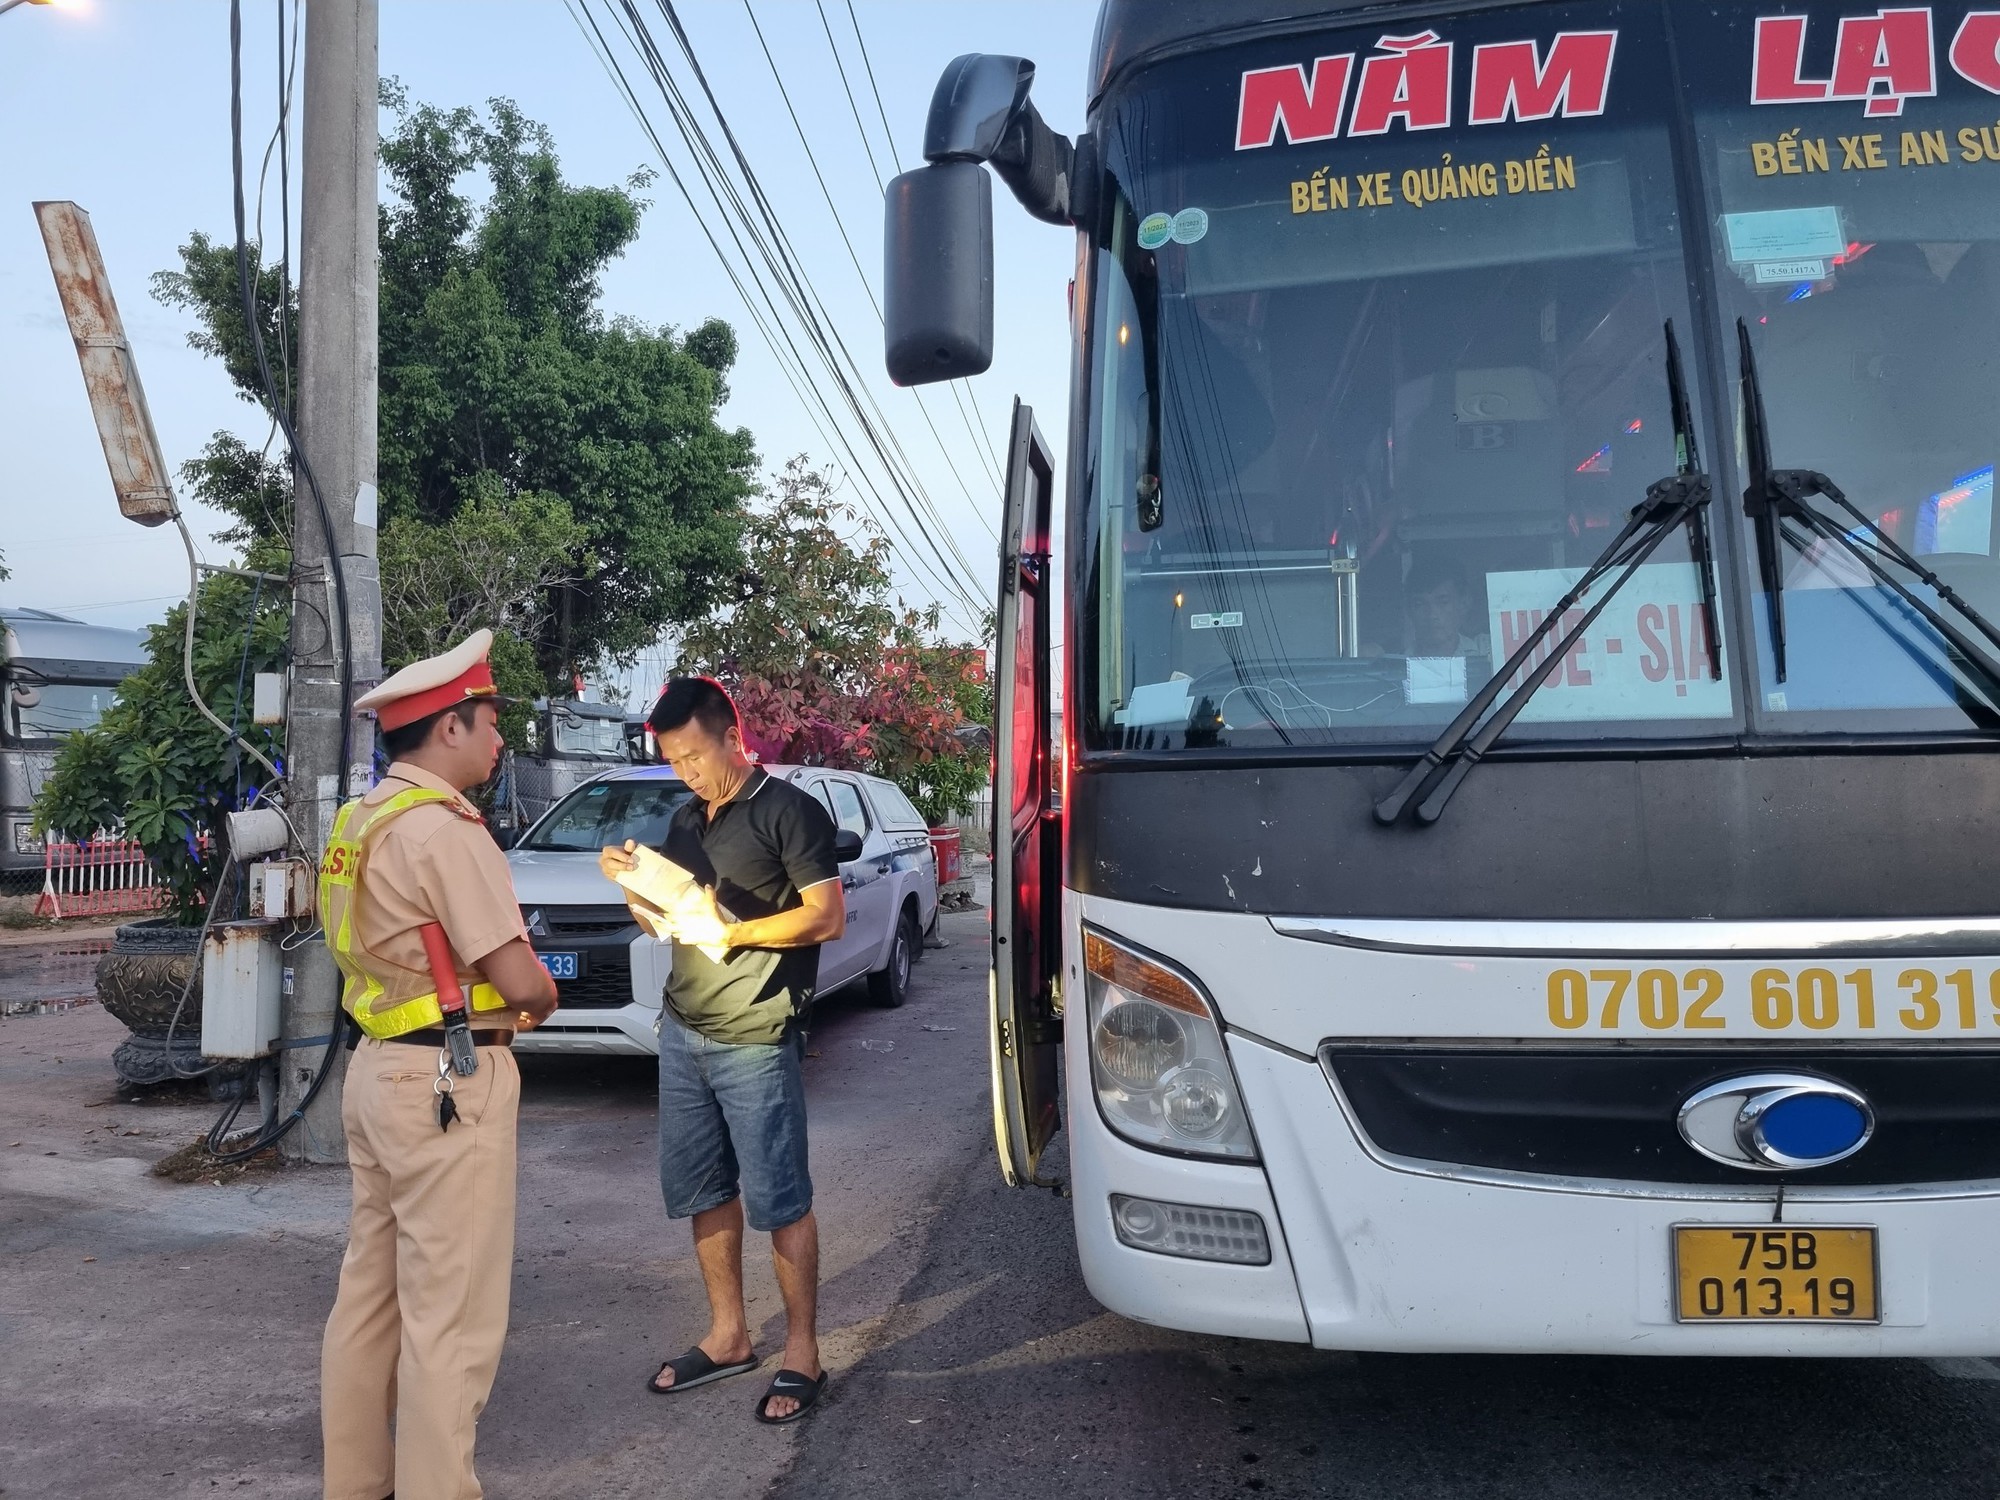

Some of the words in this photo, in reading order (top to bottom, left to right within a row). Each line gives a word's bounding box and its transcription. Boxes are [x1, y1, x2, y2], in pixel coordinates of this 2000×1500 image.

[1234, 29, 1619, 151] NĂM
[1751, 128, 1830, 177] BẾN
[1837, 133, 1889, 171] XE
[1900, 129, 1950, 166] AN
[1290, 166, 1349, 213] BẾN
[1357, 172, 1394, 207] XE
[1401, 152, 1499, 208] QUẢNG
[1504, 143, 1577, 194] ĐIỀN
[1144, 222, 1167, 233] 11/2023
[1765, 265, 1817, 276] 75.50.1417A
[1545, 967, 1727, 1031] 0702
[1749, 967, 1876, 1031] 601
[1731, 1231, 1818, 1271] 75B
[1698, 1276, 1856, 1317] 013.19
